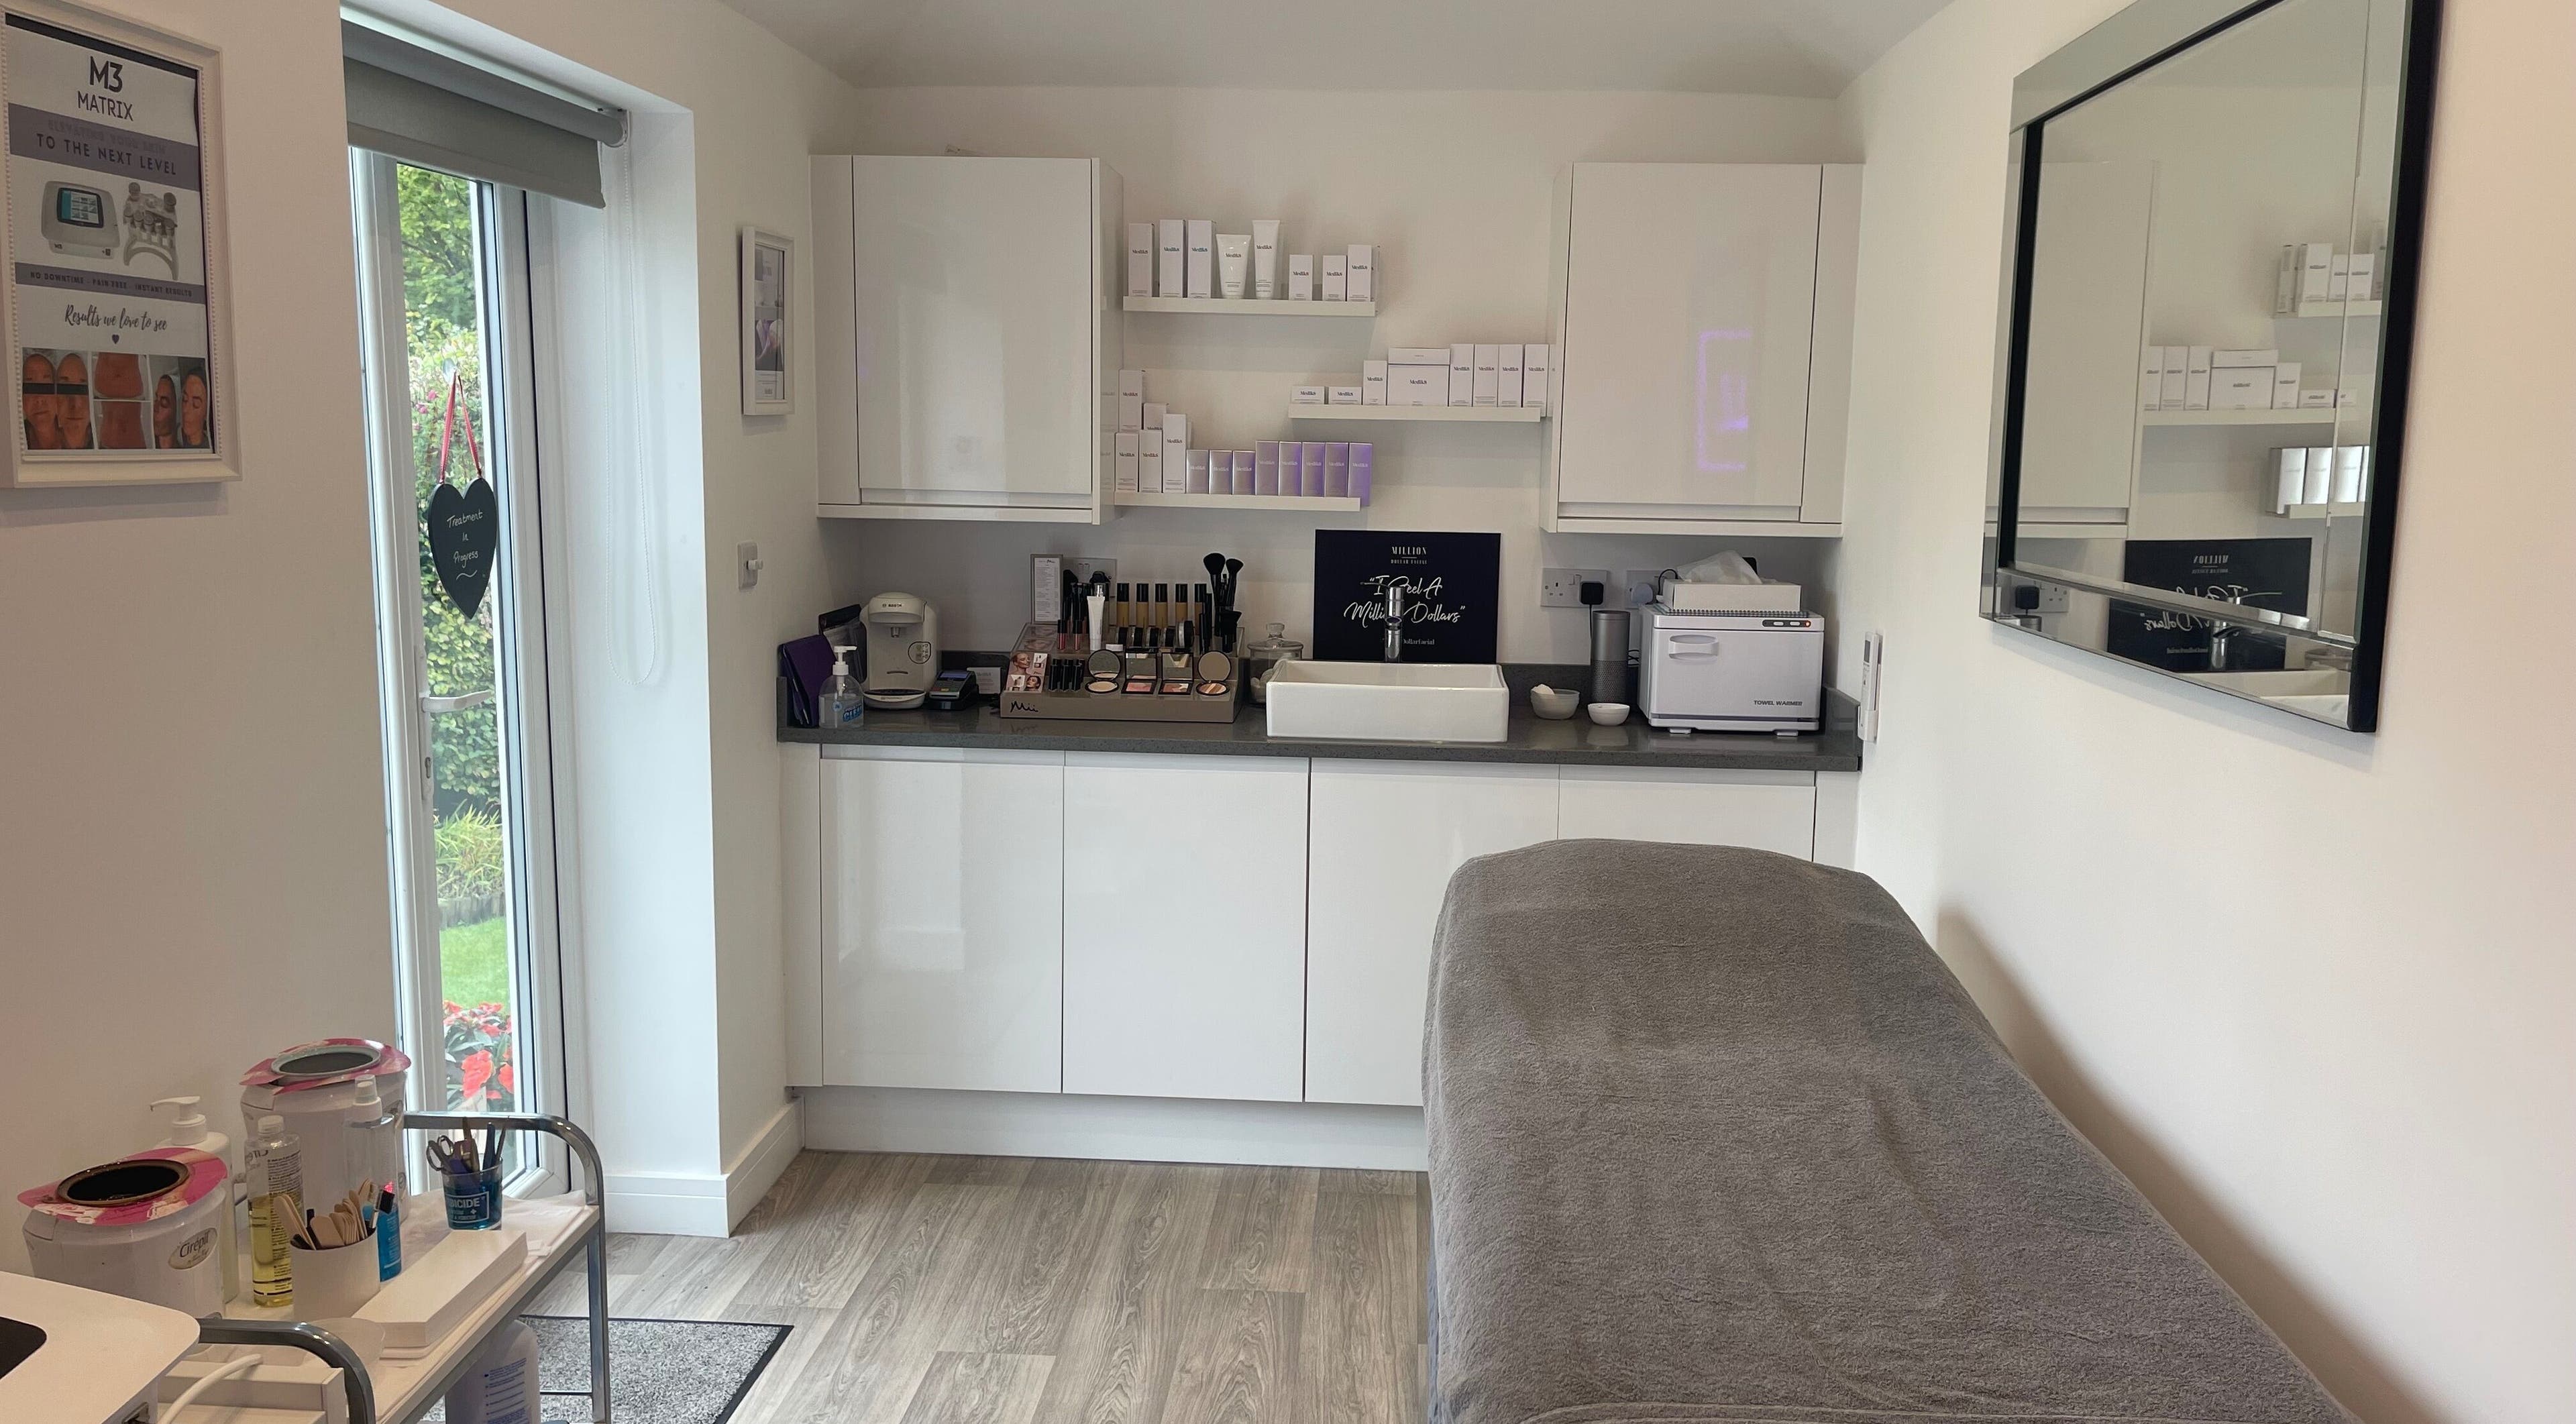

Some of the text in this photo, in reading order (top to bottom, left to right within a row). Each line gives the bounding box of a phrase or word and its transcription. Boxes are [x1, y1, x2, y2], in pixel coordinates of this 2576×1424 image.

[90, 56, 123, 93] M3
[78, 91, 133, 121] MATRIX
[36, 133, 176, 175] TO THE NEXT LEVEL
[44, 273, 84, 284] DOWNTIME
[65, 304, 168, 332] Results we love to see
[447, 509, 483, 528] Treatment
[462, 532, 469, 541] In
[453, 551, 479, 569] Progress
[1392, 546, 1427, 555] MILLION
[1424, 576, 1442, 600] A
[1344, 601, 1386, 628] Milli
